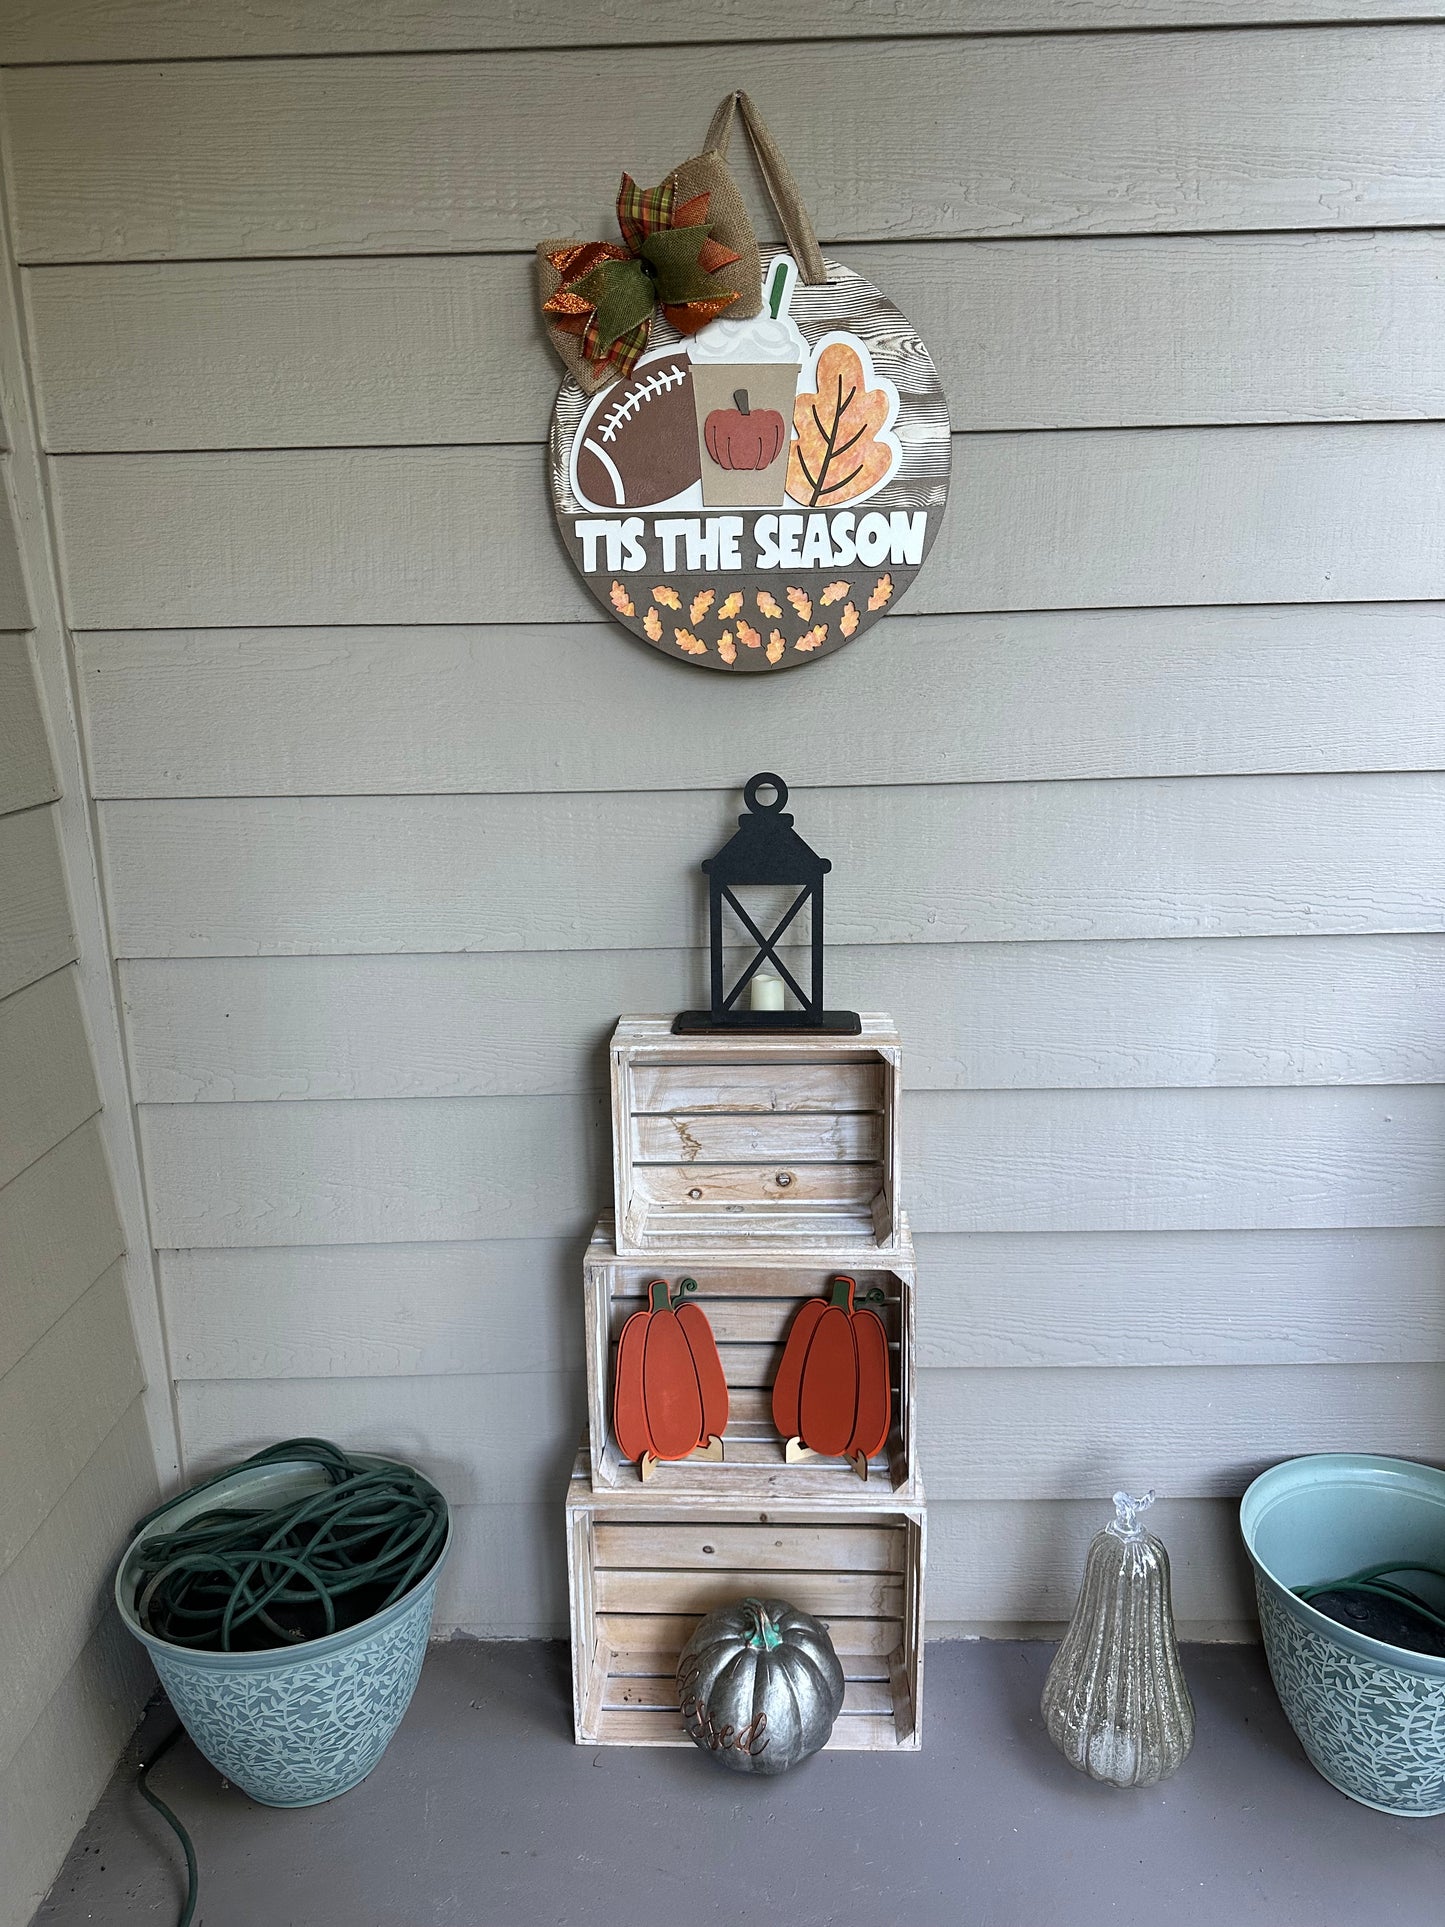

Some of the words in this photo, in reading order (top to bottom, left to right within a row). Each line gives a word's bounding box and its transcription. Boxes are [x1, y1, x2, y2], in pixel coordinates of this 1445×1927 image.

[574, 516, 647, 573] TIS
[654, 515, 743, 573] THE
[753, 510, 928, 570] SEASON
